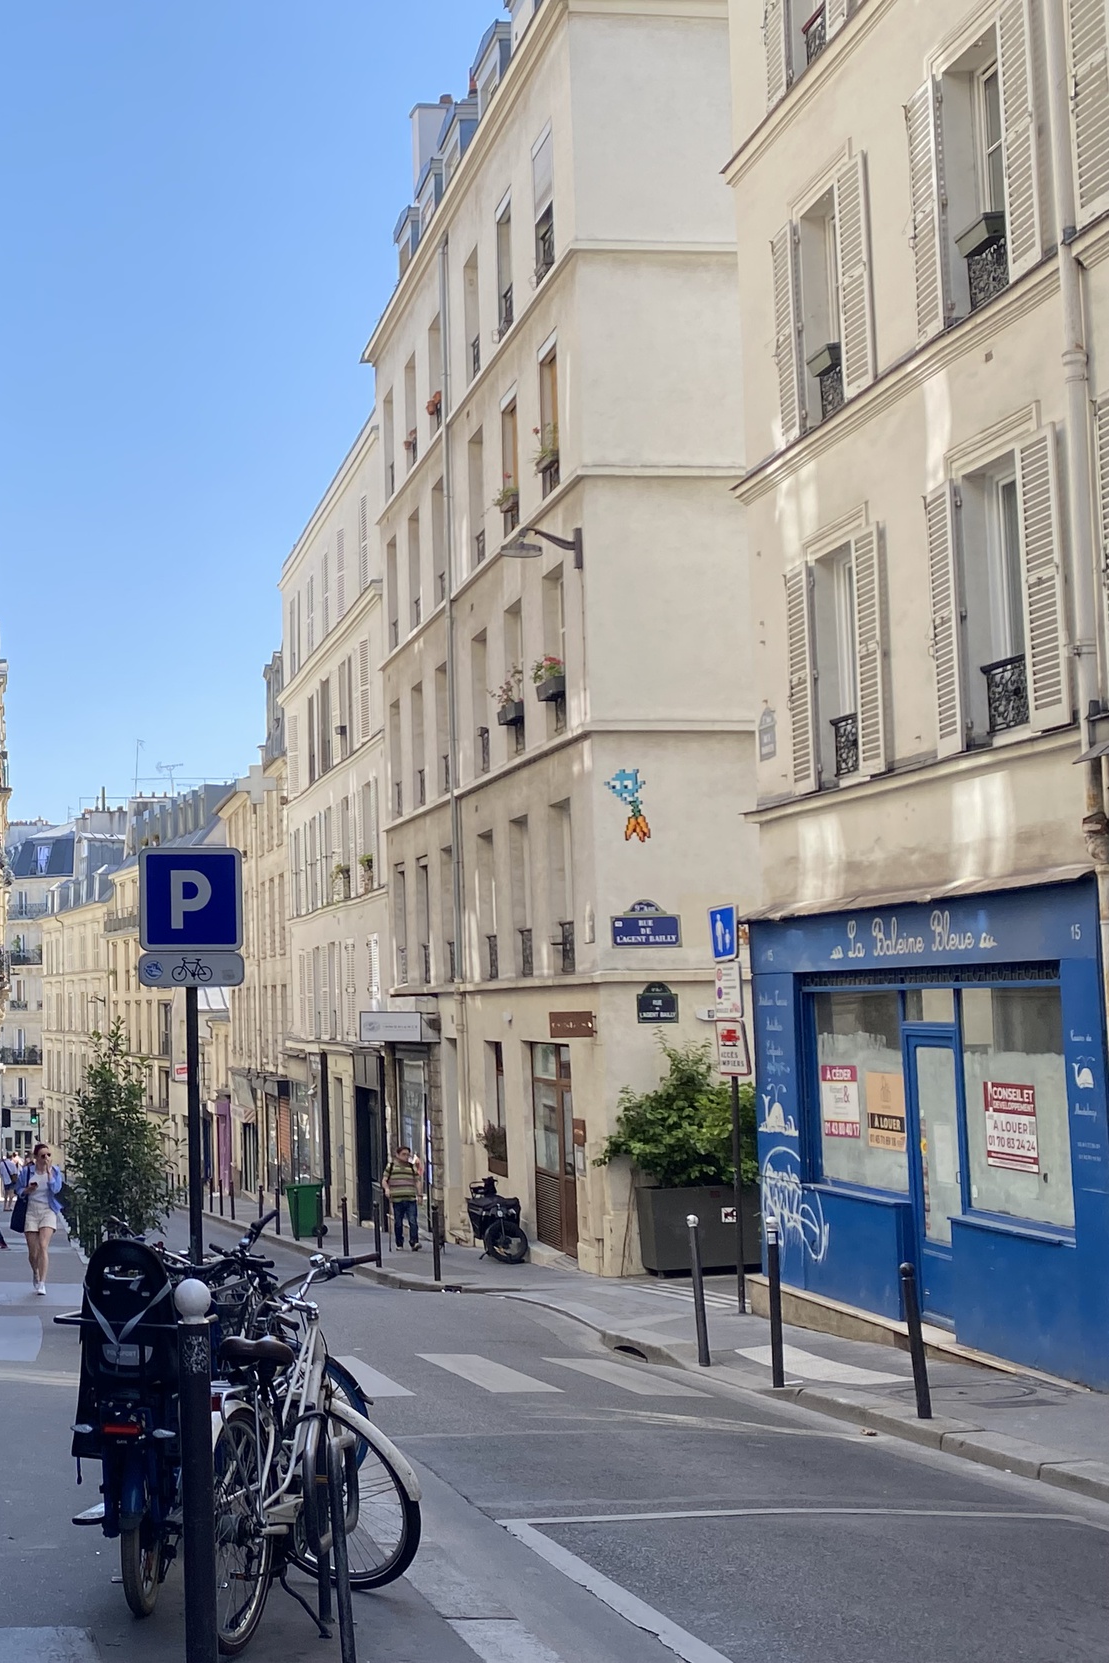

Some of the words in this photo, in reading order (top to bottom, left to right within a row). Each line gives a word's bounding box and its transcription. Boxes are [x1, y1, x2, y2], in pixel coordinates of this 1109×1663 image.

[170, 869, 213, 930] P
[616, 935, 647, 943] L'AGENT
[649, 934, 677, 942] BAILLY
[847, 920, 866, 958] La
[872, 917, 925, 956] Baleine
[930, 910, 975, 951] Bleue
[1071, 924, 1081, 940] 15
[832, 1067, 851, 1080] CÉDER
[992, 1087, 1023, 1101] CONSEIL
[1024, 1090, 1034, 1102] ET
[880, 1117, 901, 1131] LOUER
[1001, 1121, 1028, 1134] LOUER
[988, 1135, 995, 1145] 01
[997, 1136, 1005, 1147] 70
[1007, 1138, 1015, 1149] 83
[1016, 1139, 1025, 1150] 24
[1027, 1140, 1036, 1152] 24
